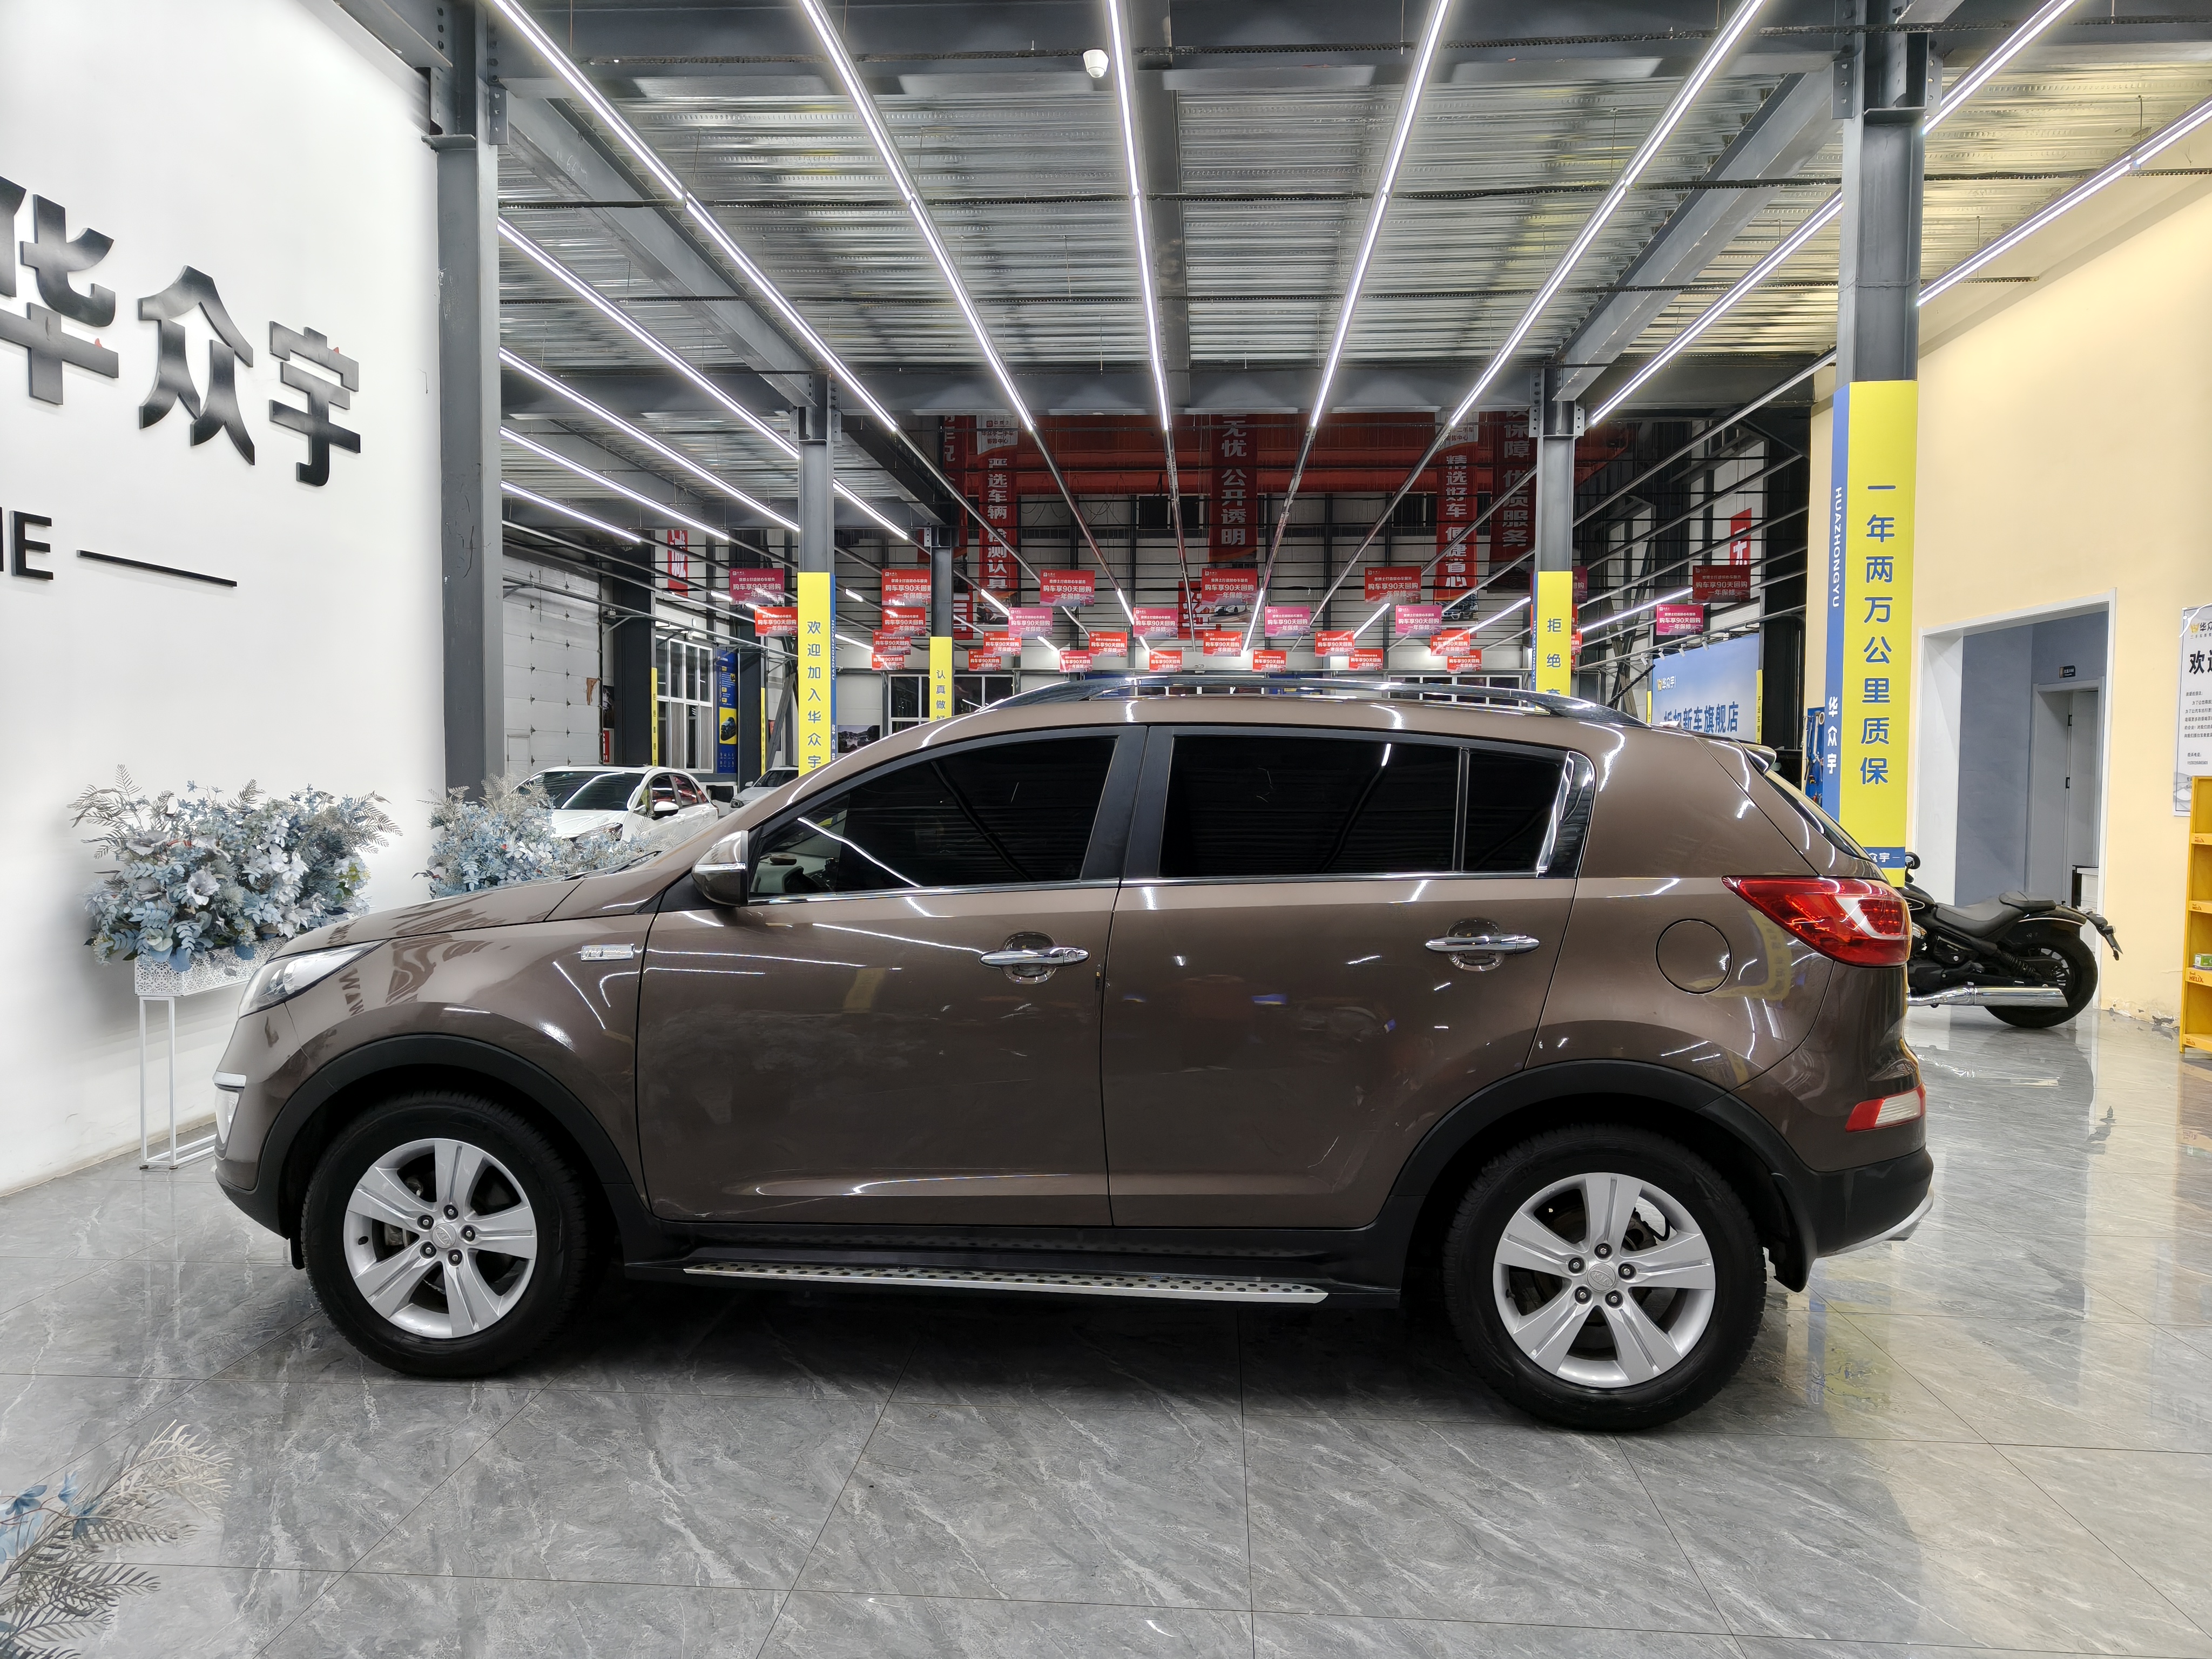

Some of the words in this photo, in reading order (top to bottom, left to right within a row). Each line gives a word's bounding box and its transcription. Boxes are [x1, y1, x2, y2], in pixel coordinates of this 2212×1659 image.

[0, 176, 360, 487] 华众宇
[987, 458, 1008, 520] 严选车辆
[1221, 469, 1247, 545] 公开透明
[1446, 455, 1467, 517] 精选好车
[0, 505, 53, 580] E
[987, 528, 1008, 589] 检测认真
[1445, 527, 1467, 587] 便捷省心
[1832, 486, 1842, 608] HUAZHONGYU
[1368, 582, 1418, 590] 购车享90天回购
[1695, 581, 1748, 589] 购车享90天回购
[1860, 484, 1897, 786] 一年两万公里质保
[807, 621, 821, 769] 欢迎加入华众宇
[1662, 676, 1675, 690] 华众宇
[1827, 696, 1838, 774] 华众宇
[2189, 975, 2204, 983] HELIX
